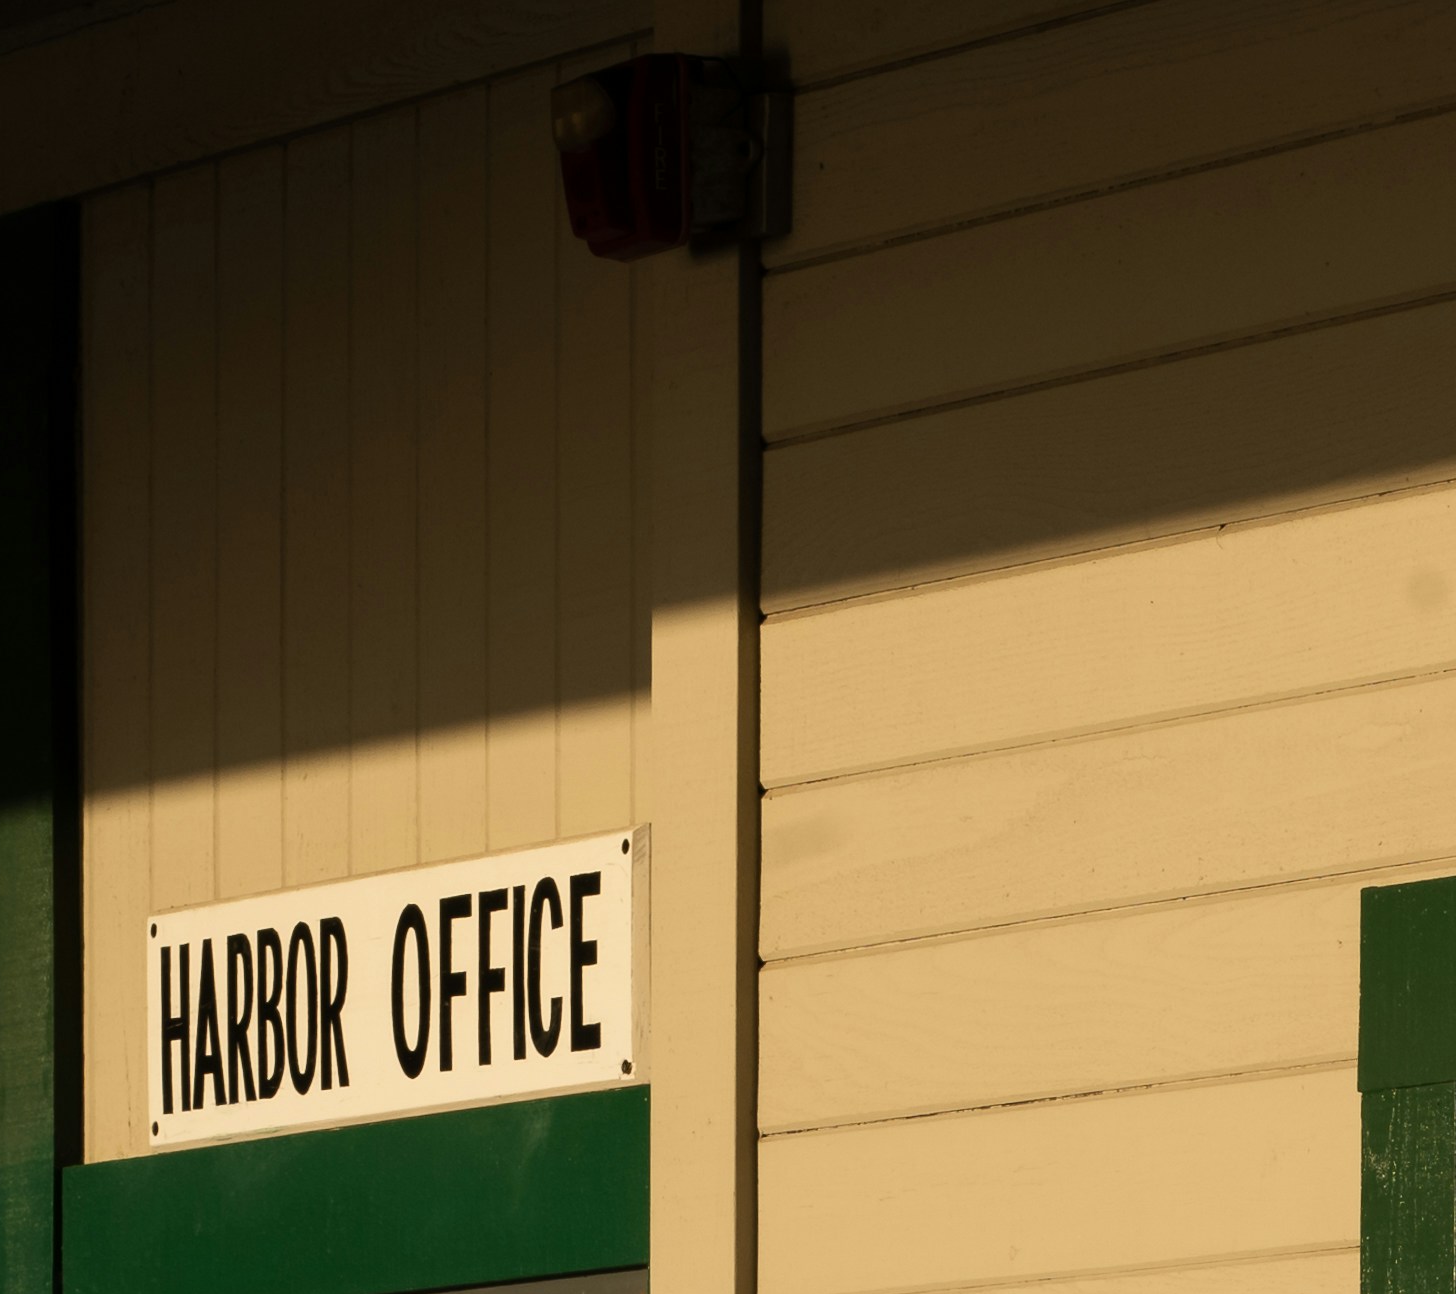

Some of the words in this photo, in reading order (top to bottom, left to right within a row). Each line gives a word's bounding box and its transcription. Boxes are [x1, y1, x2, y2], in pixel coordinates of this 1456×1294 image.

[654, 102, 667, 190] FIRE
[160, 915, 350, 1115] HARBOR
[391, 870, 602, 1080] OFFICE
